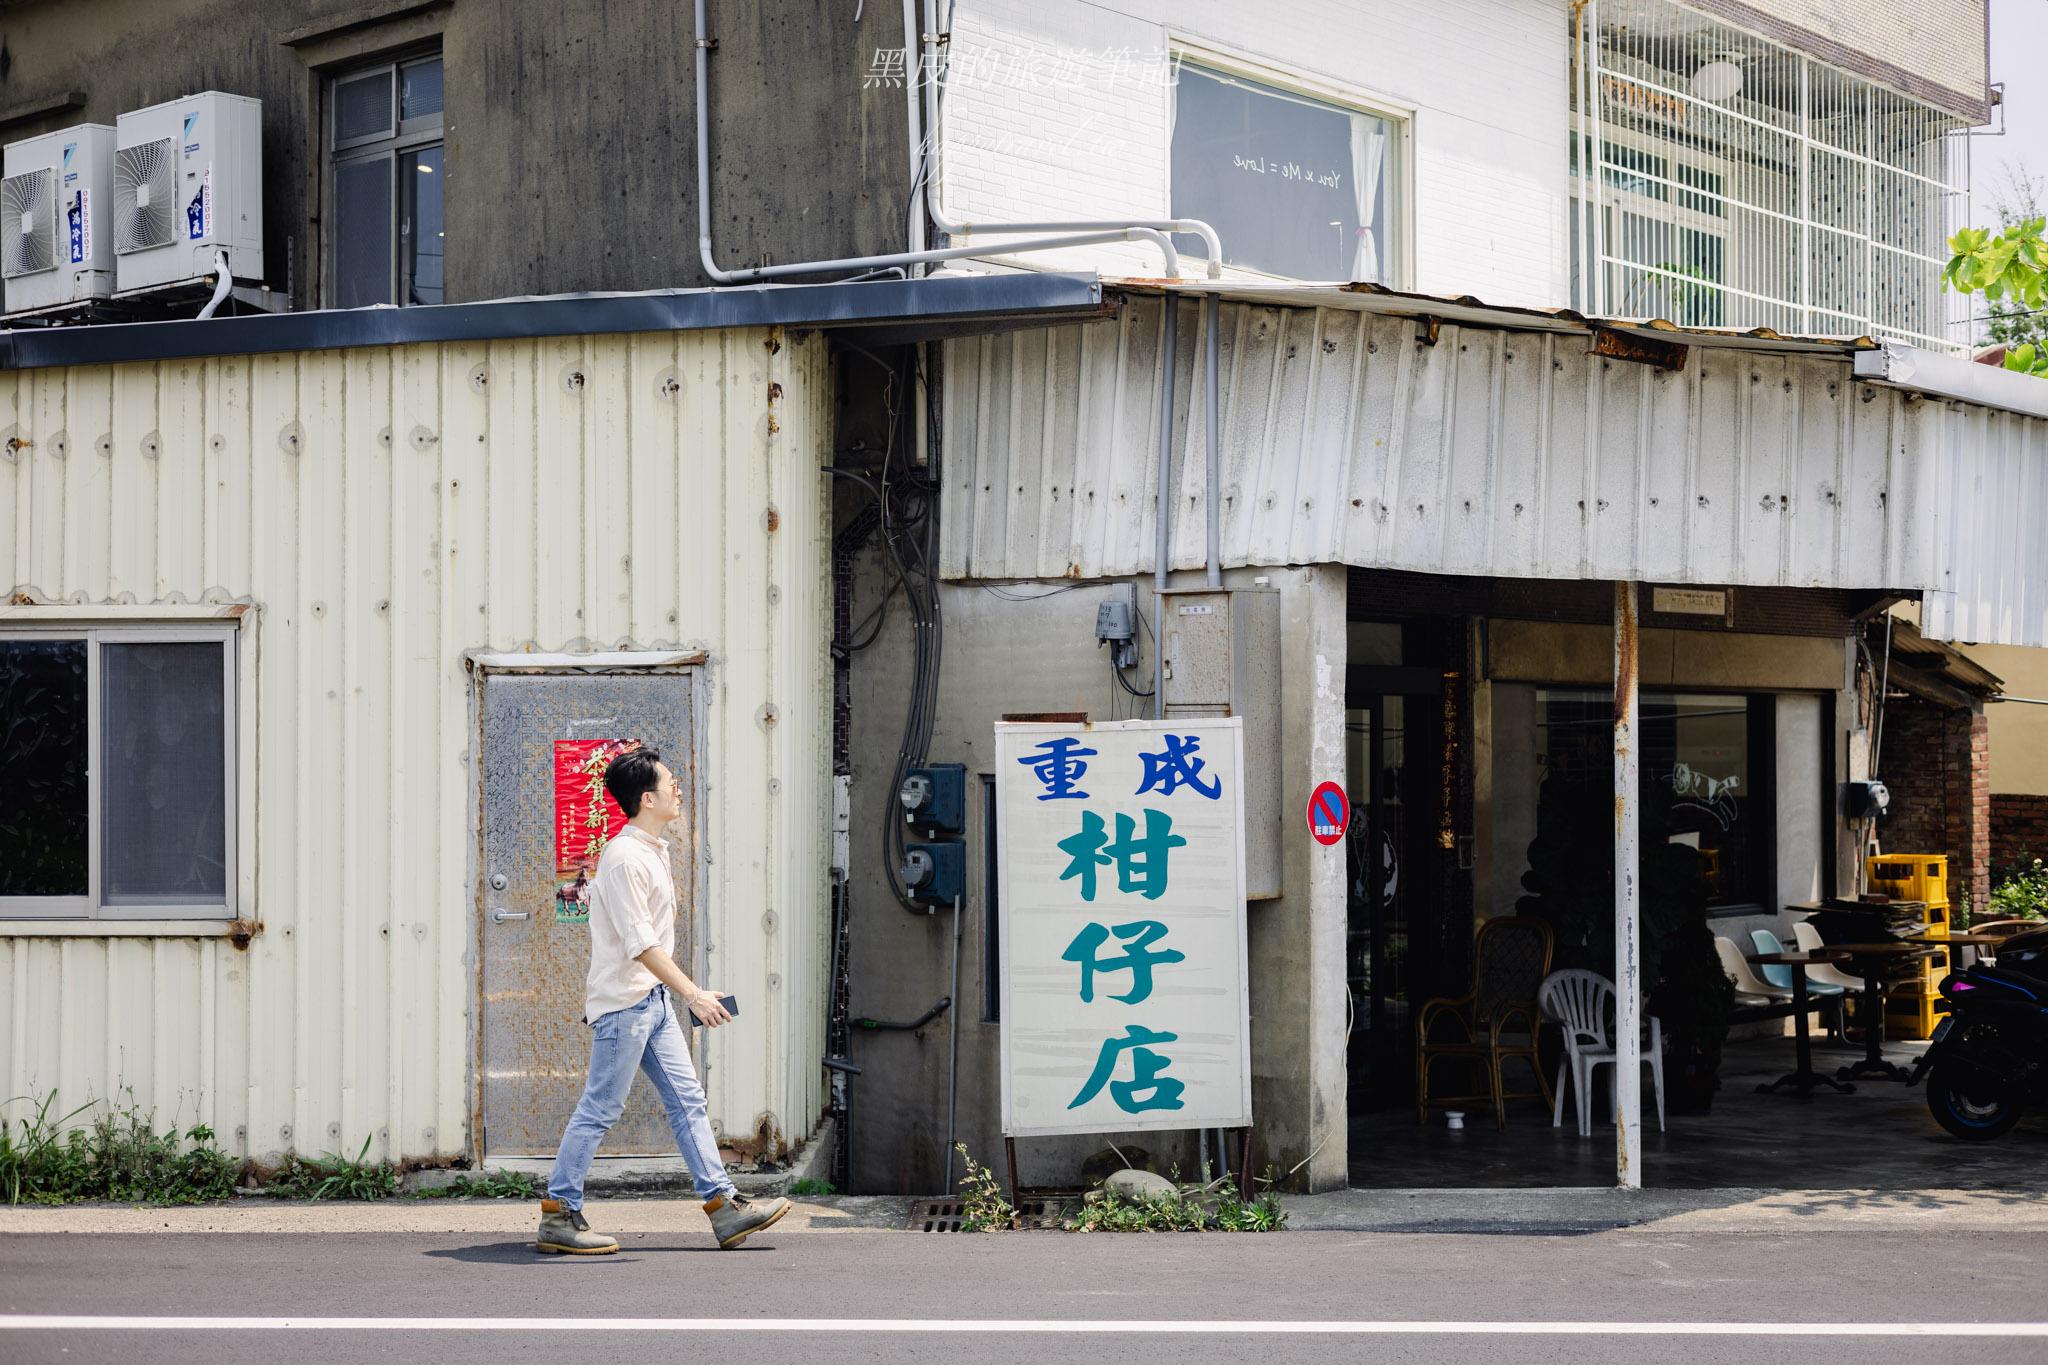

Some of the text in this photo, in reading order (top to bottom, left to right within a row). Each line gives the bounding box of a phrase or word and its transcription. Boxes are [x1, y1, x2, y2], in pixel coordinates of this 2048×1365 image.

[1018, 735, 1222, 801] 重成
[1057, 808, 1187, 1115] 柑仔店
